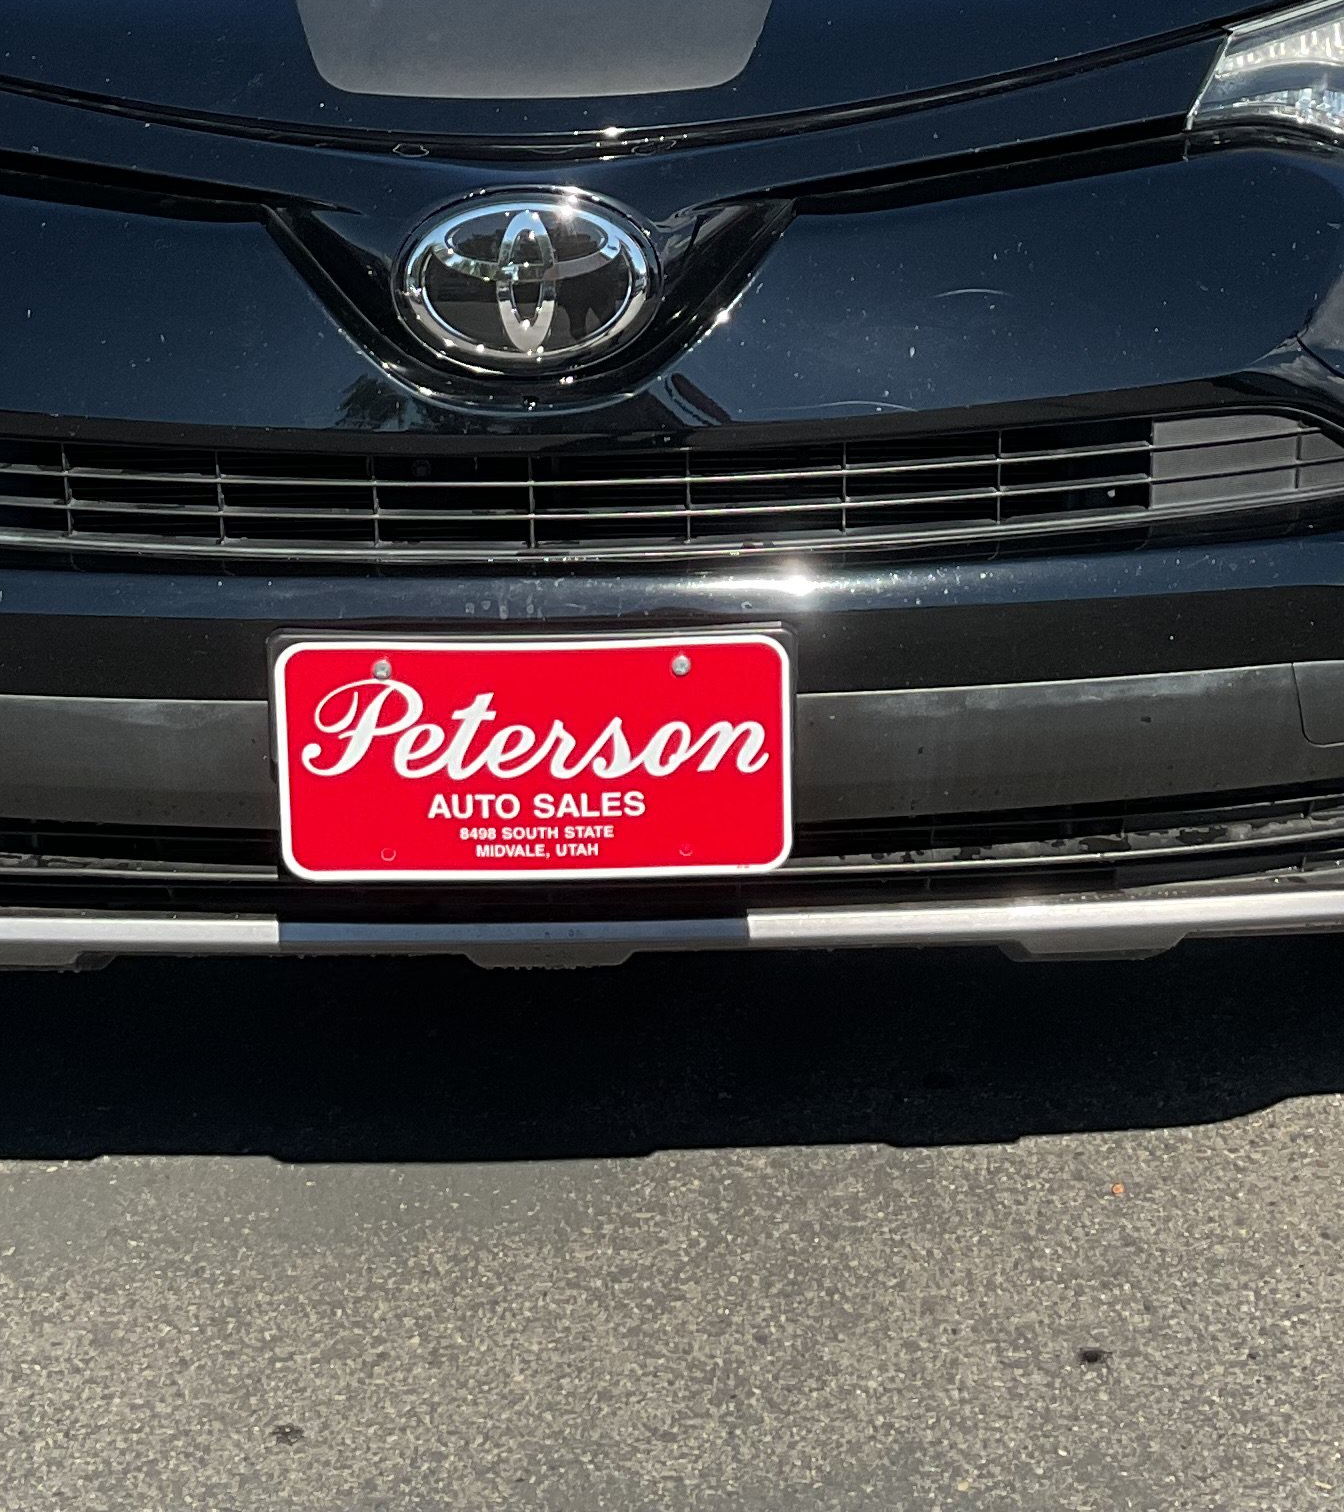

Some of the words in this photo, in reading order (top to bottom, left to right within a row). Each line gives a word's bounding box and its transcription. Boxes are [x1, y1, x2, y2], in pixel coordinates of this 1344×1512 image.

[301, 678, 769, 780] Peterson
[427, 793, 521, 819] AUTO
[533, 791, 646, 819] SALES
[459, 827, 497, 840] 8498
[502, 826, 559, 840] SOUTH
[564, 825, 614, 839] STATE
[476, 843, 550, 859] MIDVALE,
[556, 842, 599, 857] UTAH
